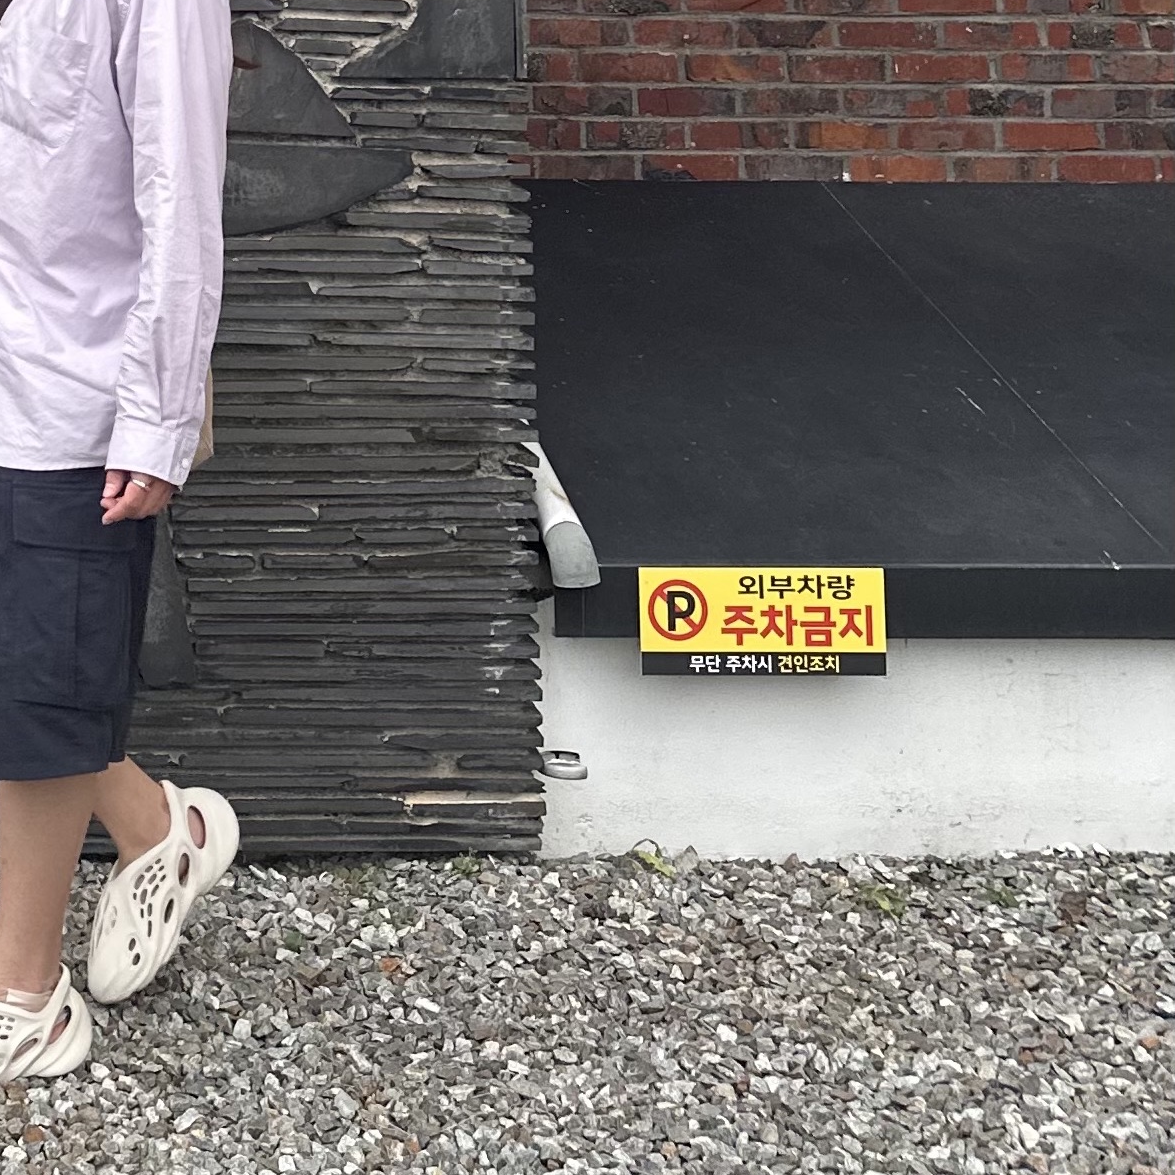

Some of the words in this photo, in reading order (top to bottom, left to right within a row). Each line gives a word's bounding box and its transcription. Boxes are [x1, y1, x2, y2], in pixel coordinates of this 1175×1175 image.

[738, 575, 855, 599] 외부차량
[721, 605, 874, 646] 주차금지
[689, 654, 721, 673] 무단
[725, 654, 773, 673] 주차시
[777, 654, 840, 673] 견인조치
